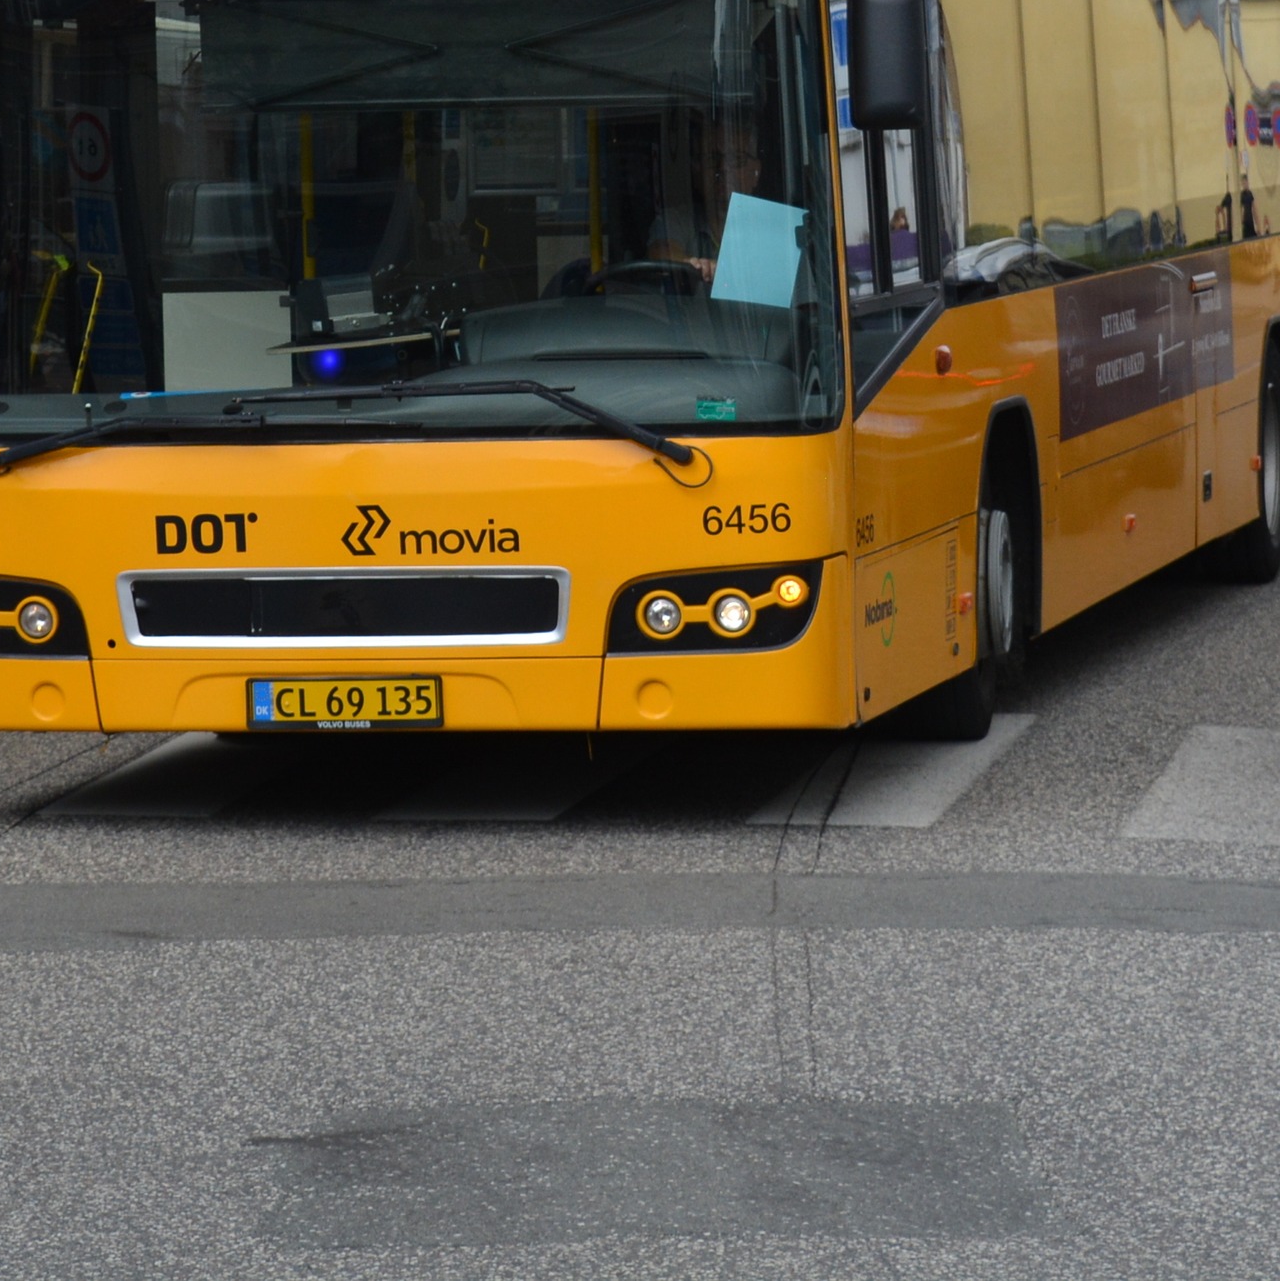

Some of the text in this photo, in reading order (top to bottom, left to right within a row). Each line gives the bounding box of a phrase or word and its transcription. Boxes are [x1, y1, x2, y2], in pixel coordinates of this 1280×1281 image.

[155, 512, 258, 555] DOT
[702, 503, 791, 536] 6456
[856, 514, 875, 548] 6456
[399, 518, 521, 556] movia
[255, 685, 432, 717] DK CL 69 135
[317, 720, 371, 729] VOLVO BUSES
